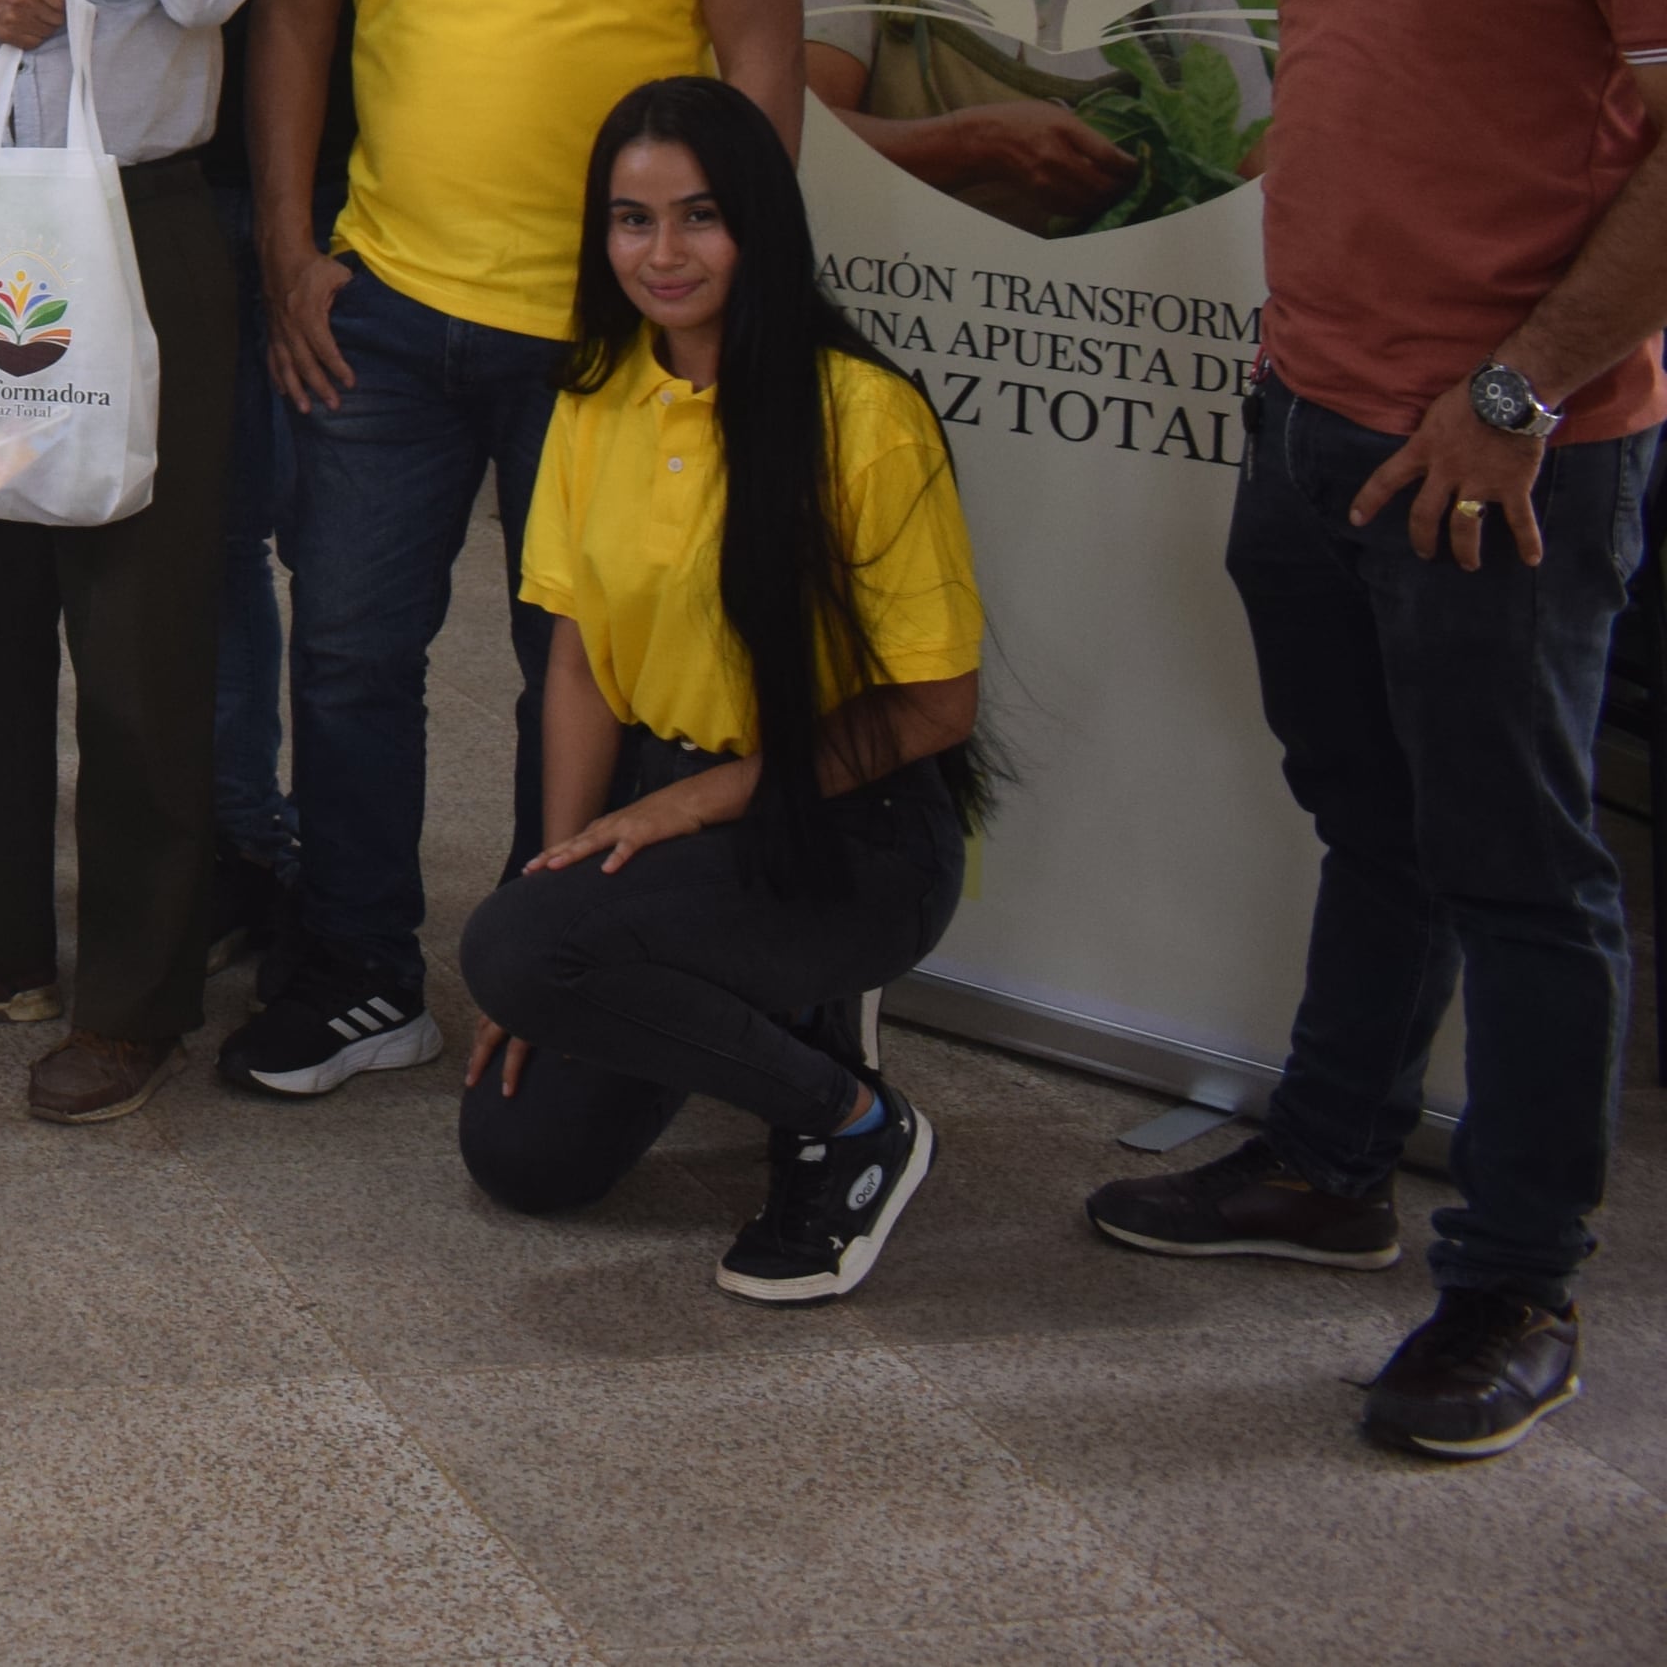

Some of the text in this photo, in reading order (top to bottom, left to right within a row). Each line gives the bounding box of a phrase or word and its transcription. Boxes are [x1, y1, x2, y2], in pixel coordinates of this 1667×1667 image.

[973, 269, 1263, 346] TRANSFORM
[946, 320, 1179, 387] APUESTA
[14, 404, 52, 418] Total
[998, 380, 1242, 467] TOTAL
